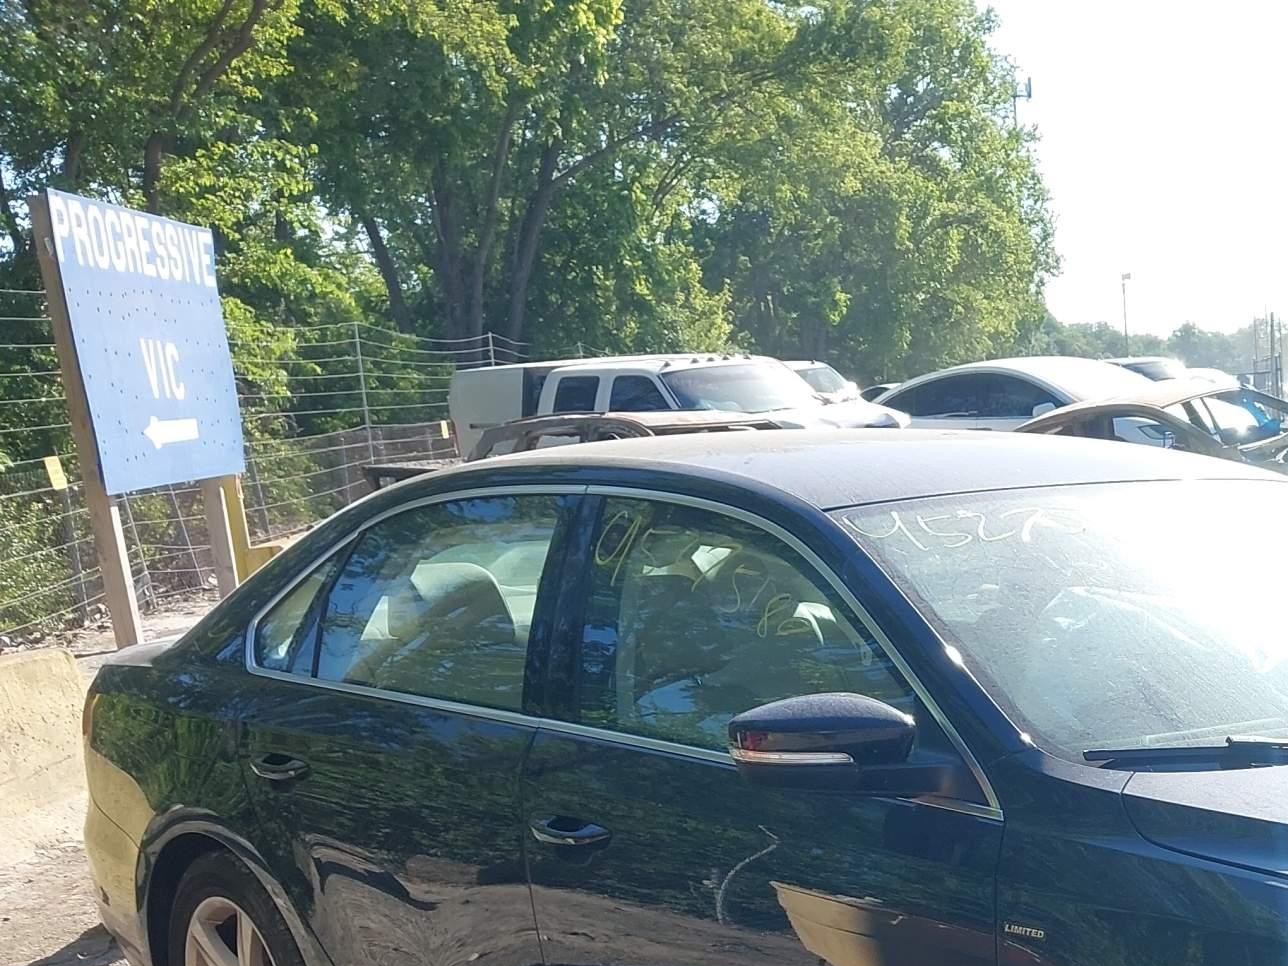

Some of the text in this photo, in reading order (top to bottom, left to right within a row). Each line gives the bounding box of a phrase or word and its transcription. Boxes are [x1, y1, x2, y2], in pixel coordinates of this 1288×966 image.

[50, 195, 216, 287] PROGRESSIVE
[140, 338, 185, 400] VIC
[1004, 923, 1044, 938] LIMITED
